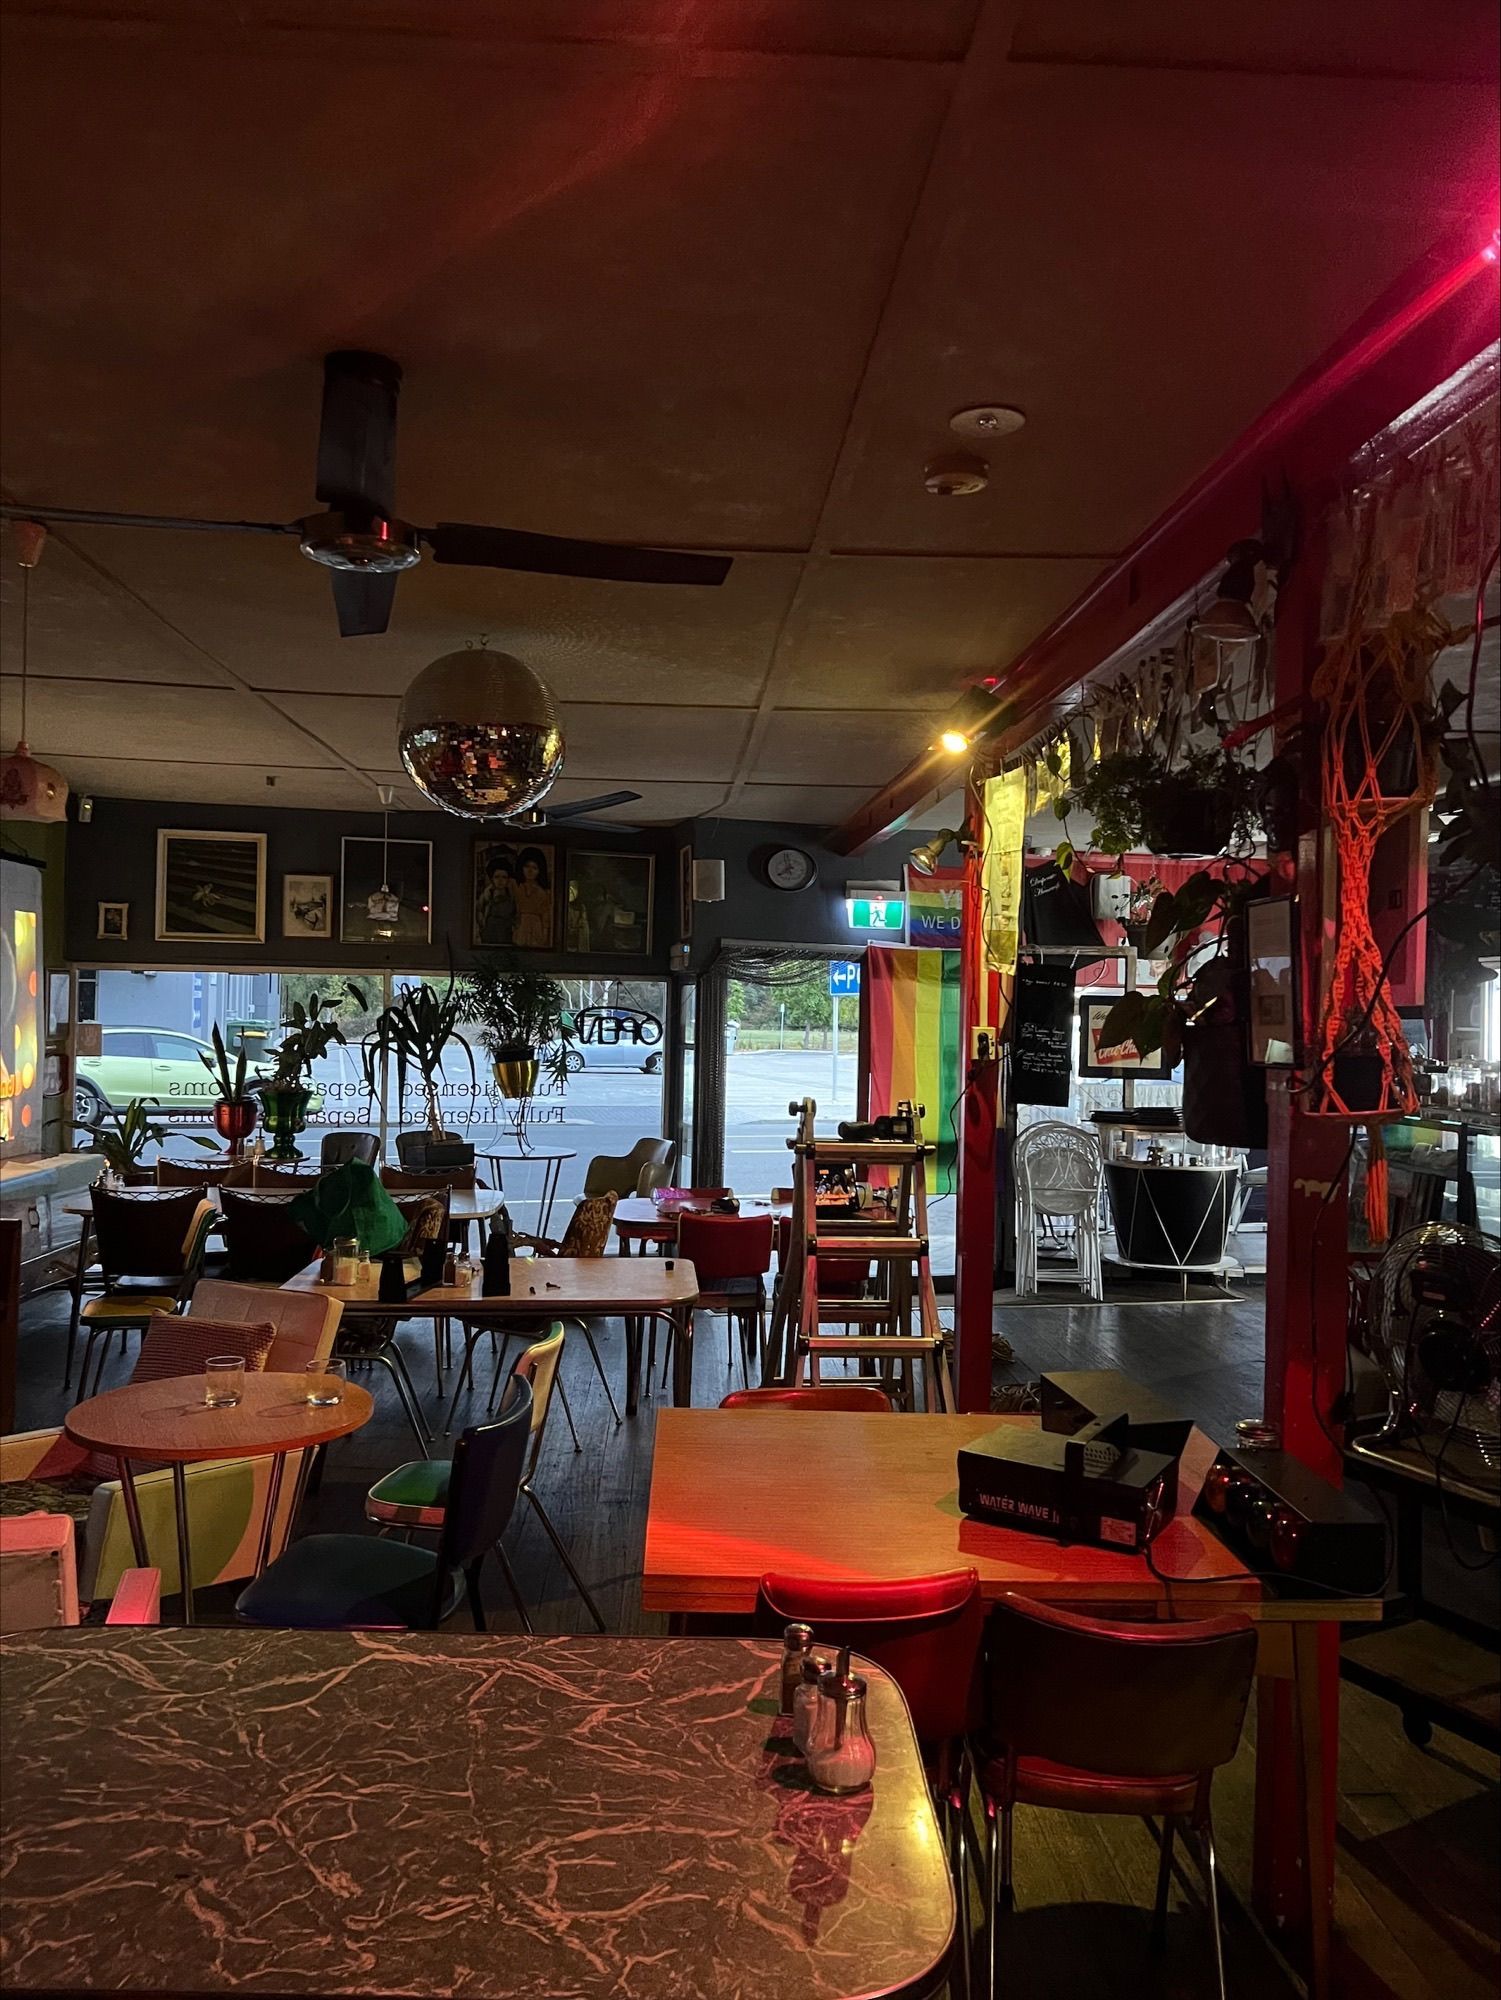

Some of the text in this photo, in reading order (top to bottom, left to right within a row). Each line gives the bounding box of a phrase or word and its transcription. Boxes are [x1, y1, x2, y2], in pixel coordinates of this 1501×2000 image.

[921, 915, 961, 930] WE D
[979, 1493, 1015, 1512] WATER
[1017, 1502, 1049, 1519] WAVE
